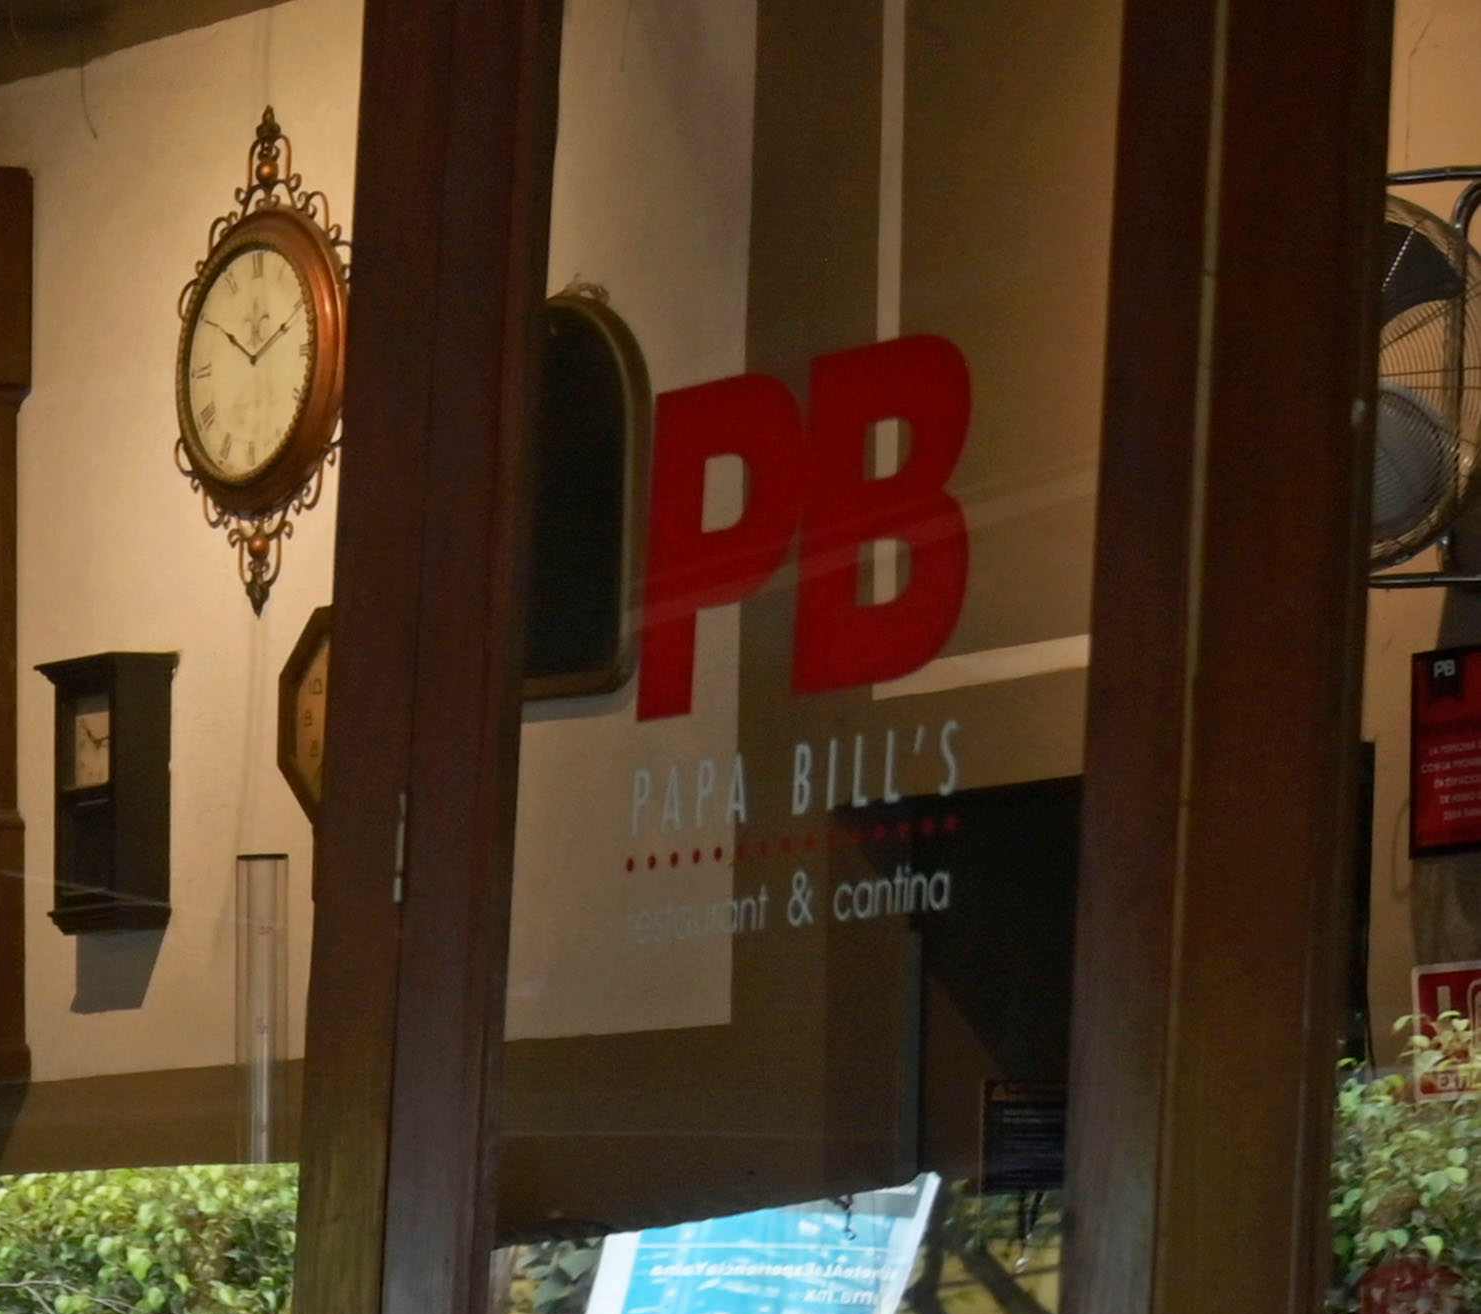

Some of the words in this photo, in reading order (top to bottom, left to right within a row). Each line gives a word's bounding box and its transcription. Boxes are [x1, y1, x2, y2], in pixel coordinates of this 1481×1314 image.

[637, 335, 972, 721] PB
[629, 752, 747, 837] PAPA
[791, 720, 964, 815] BILL'S
[788, 869, 815, 928] &
[834, 863, 952, 922] cantina
